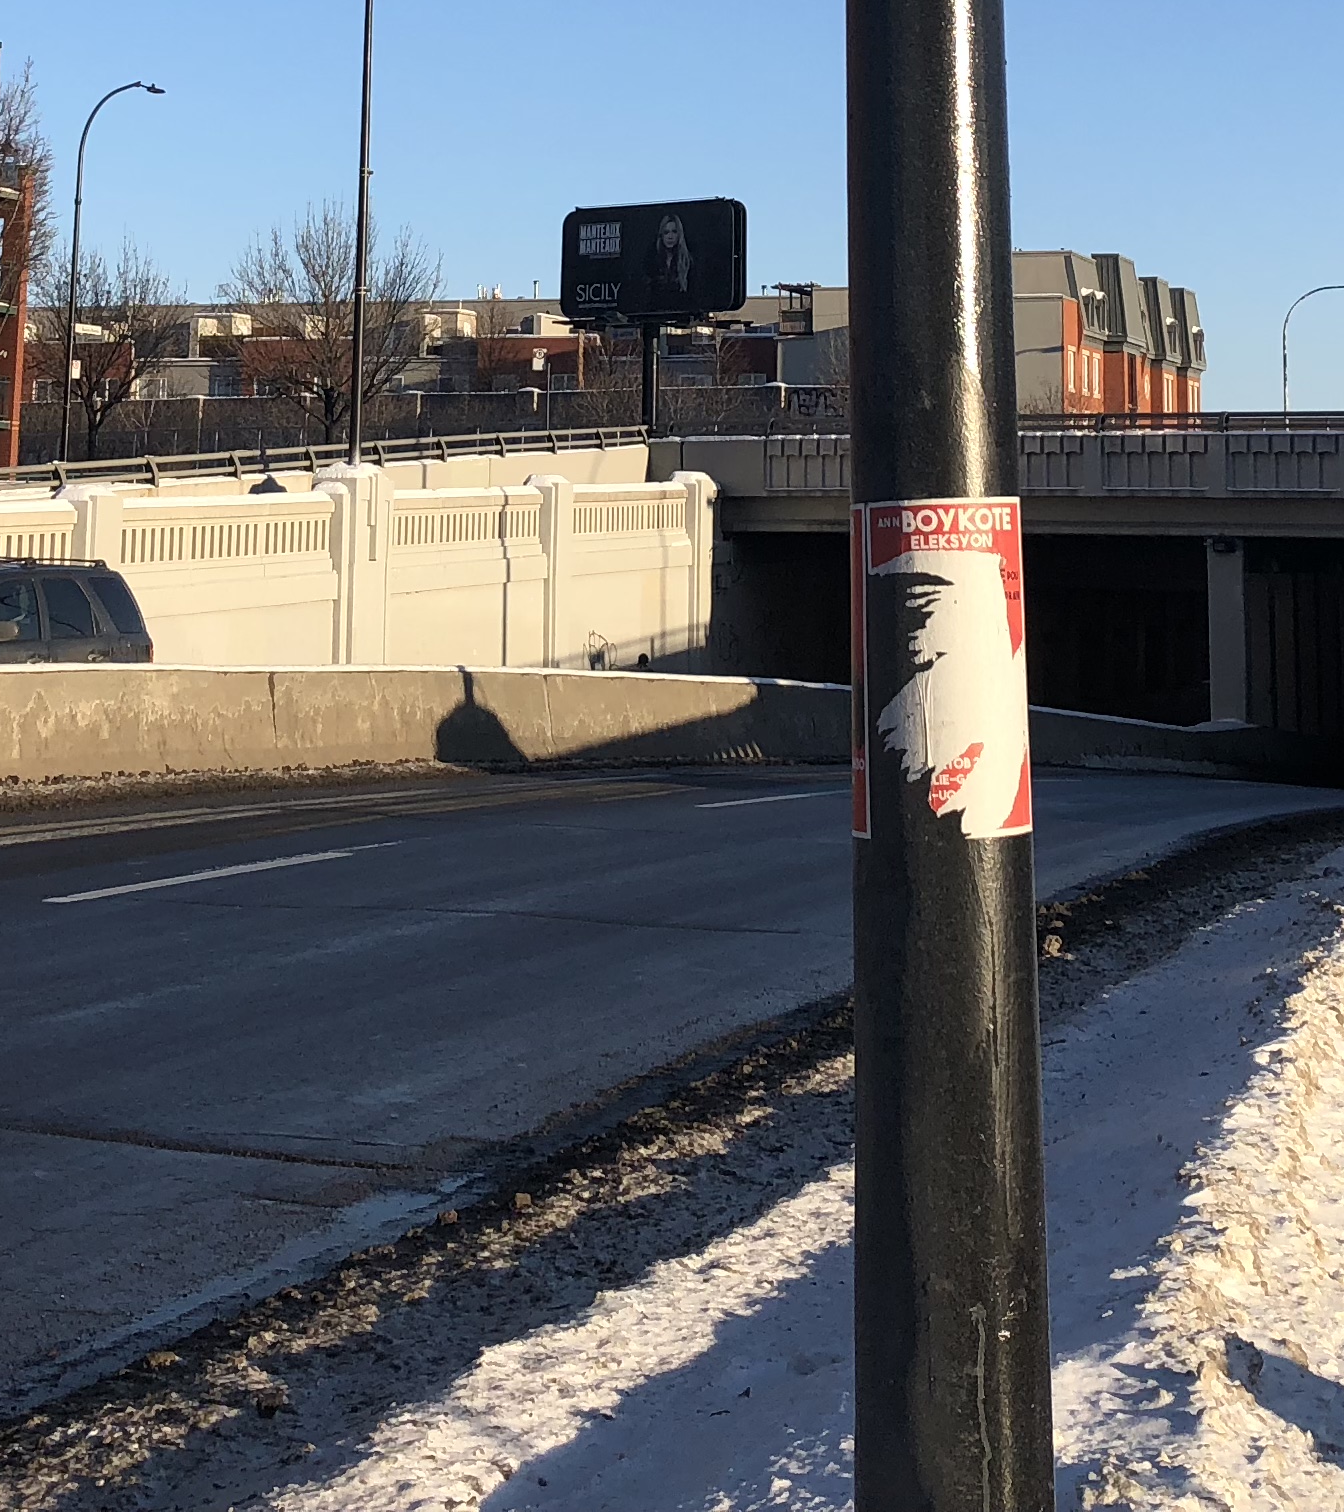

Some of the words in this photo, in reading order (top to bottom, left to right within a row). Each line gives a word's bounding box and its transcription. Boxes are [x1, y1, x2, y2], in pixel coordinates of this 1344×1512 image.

[579, 223, 621, 239] MANTEAUX
[579, 238, 621, 255] MANTEAUX
[575, 282, 622, 302] SICILY
[901, 507, 1011, 533] BOYKOTE
[910, 533, 993, 550] ELEKSYON
